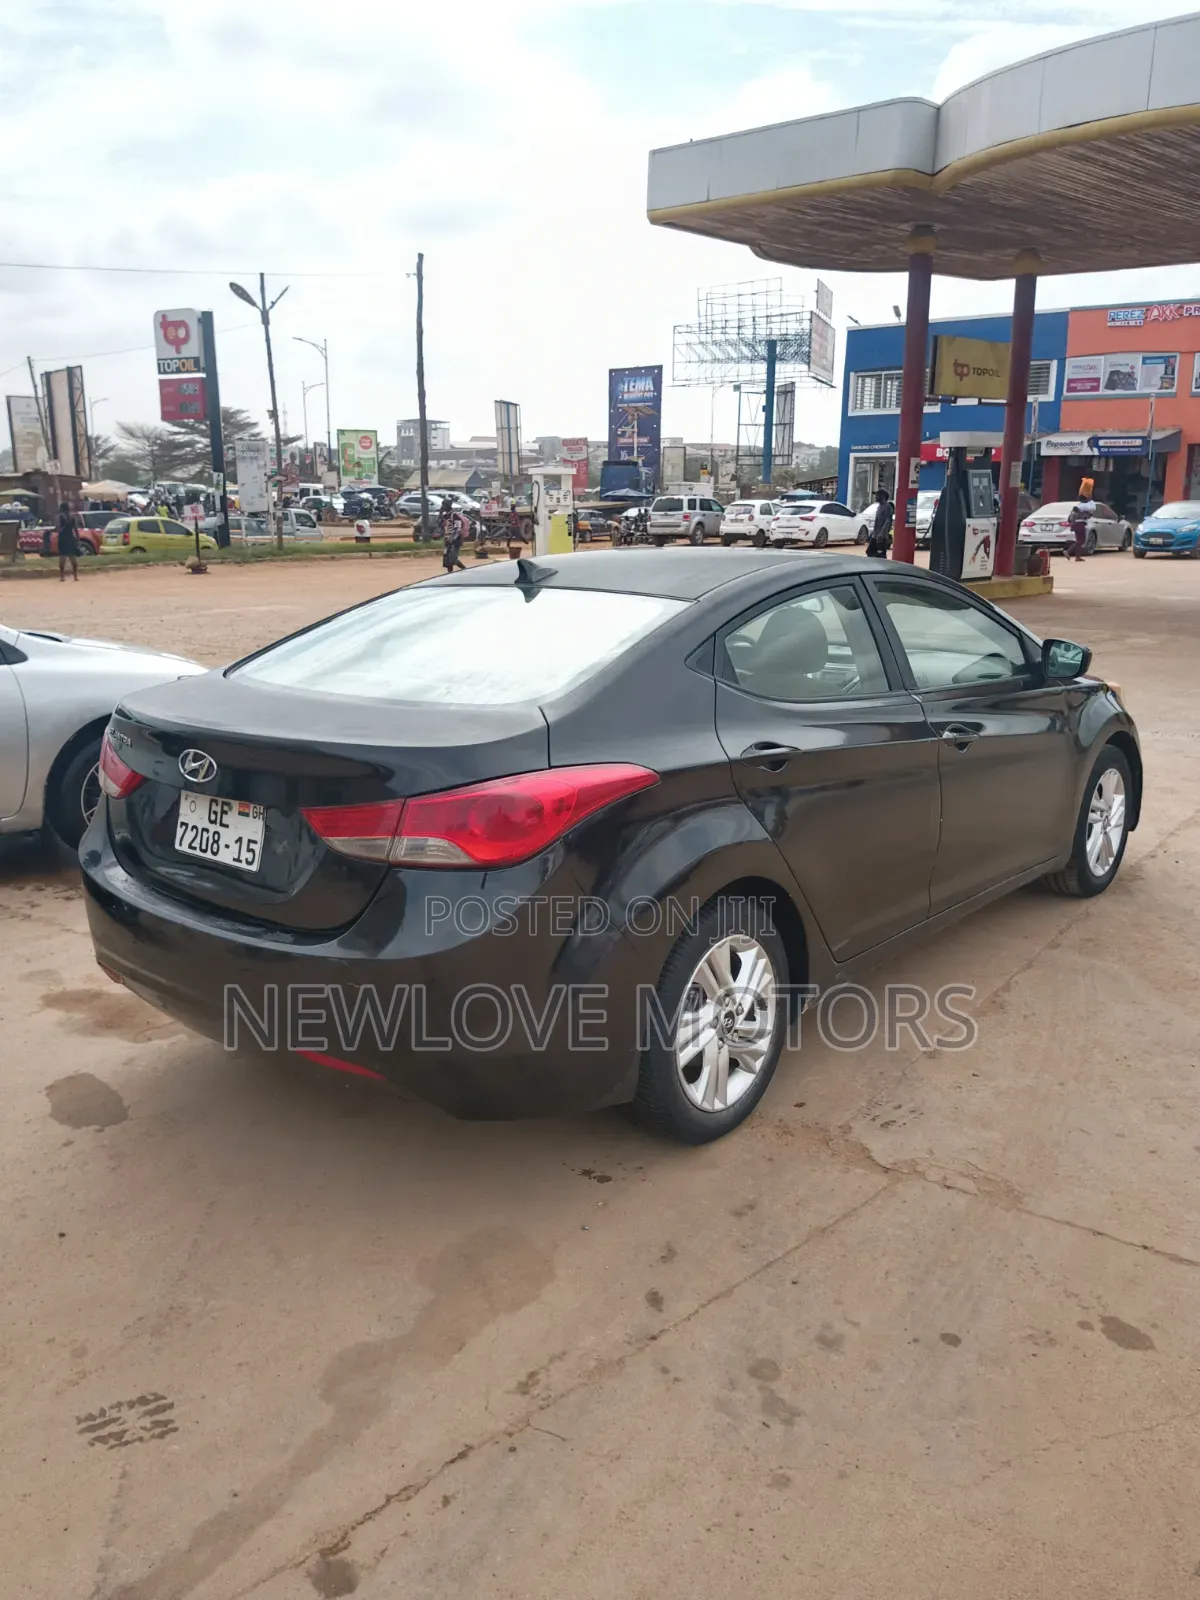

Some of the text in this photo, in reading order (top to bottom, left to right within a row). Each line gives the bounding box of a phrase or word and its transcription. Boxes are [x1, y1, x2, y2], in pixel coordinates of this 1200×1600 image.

[1108, 308, 1145, 321] PEREZ
[158, 359, 198, 373] TOPOIL
[972, 366, 1002, 378] TOPOIL
[623, 376, 655, 393] TEMA
[1046, 440, 1085, 451] Pepsodent
[208, 798, 265, 829] GE GH
[178, 821, 259, 867] 7208-15
